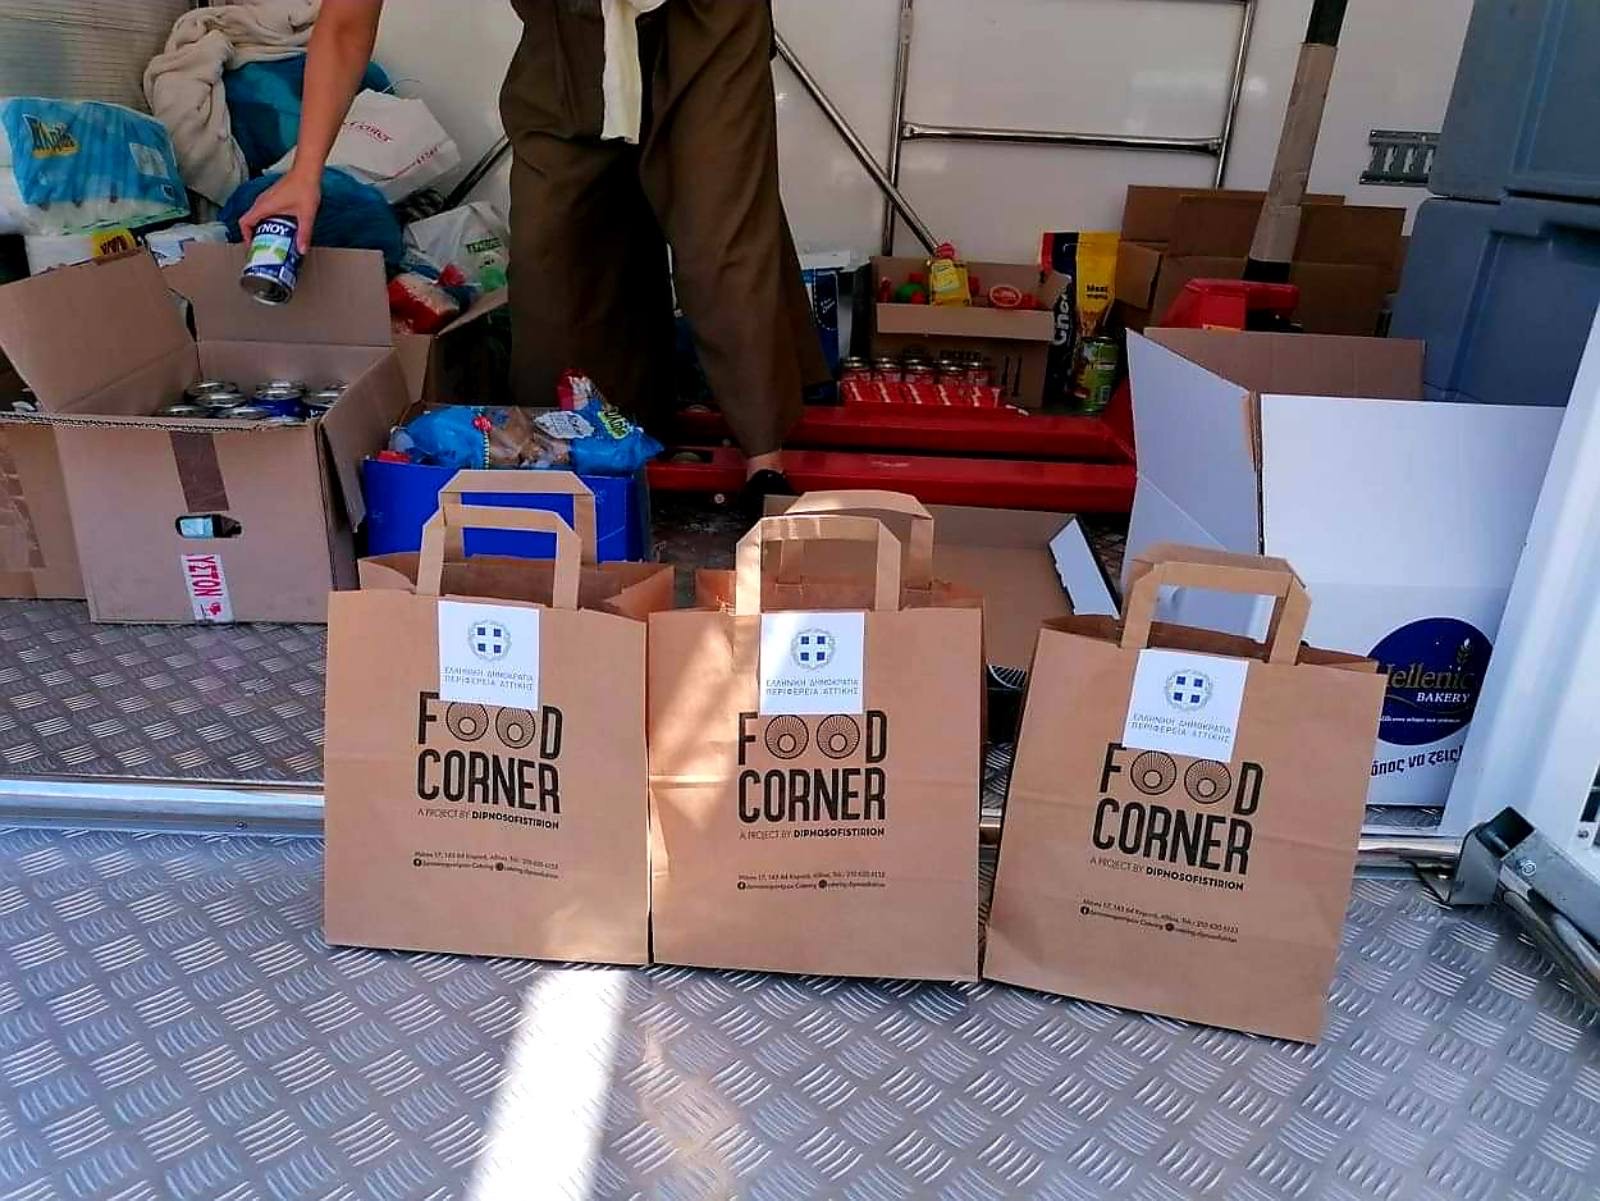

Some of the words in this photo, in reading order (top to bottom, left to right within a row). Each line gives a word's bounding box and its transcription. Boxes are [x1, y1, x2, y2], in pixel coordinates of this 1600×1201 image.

[766, 687, 819, 696] ΠΕΡΙΦΕΡΕΙΑ
[823, 687, 859, 695] ΑΤΤΙΚΗΣ
[1416, 692, 1470, 703] BAKERY
[418, 691, 563, 760] FOOD
[738, 710, 887, 765] FOOD
[1099, 742, 1263, 816] FOOD
[1408, 754, 1425, 768] να
[417, 749, 561, 814] CORNER
[738, 767, 886, 823] CORNER
[471, 811, 559, 829] DIPNOSOFISTIRION
[793, 827, 885, 838] DIPNOSOFISTIRION
[1092, 797, 1253, 875] CORNER
[1145, 866, 1244, 891] DIPNOSOFISTIRION
